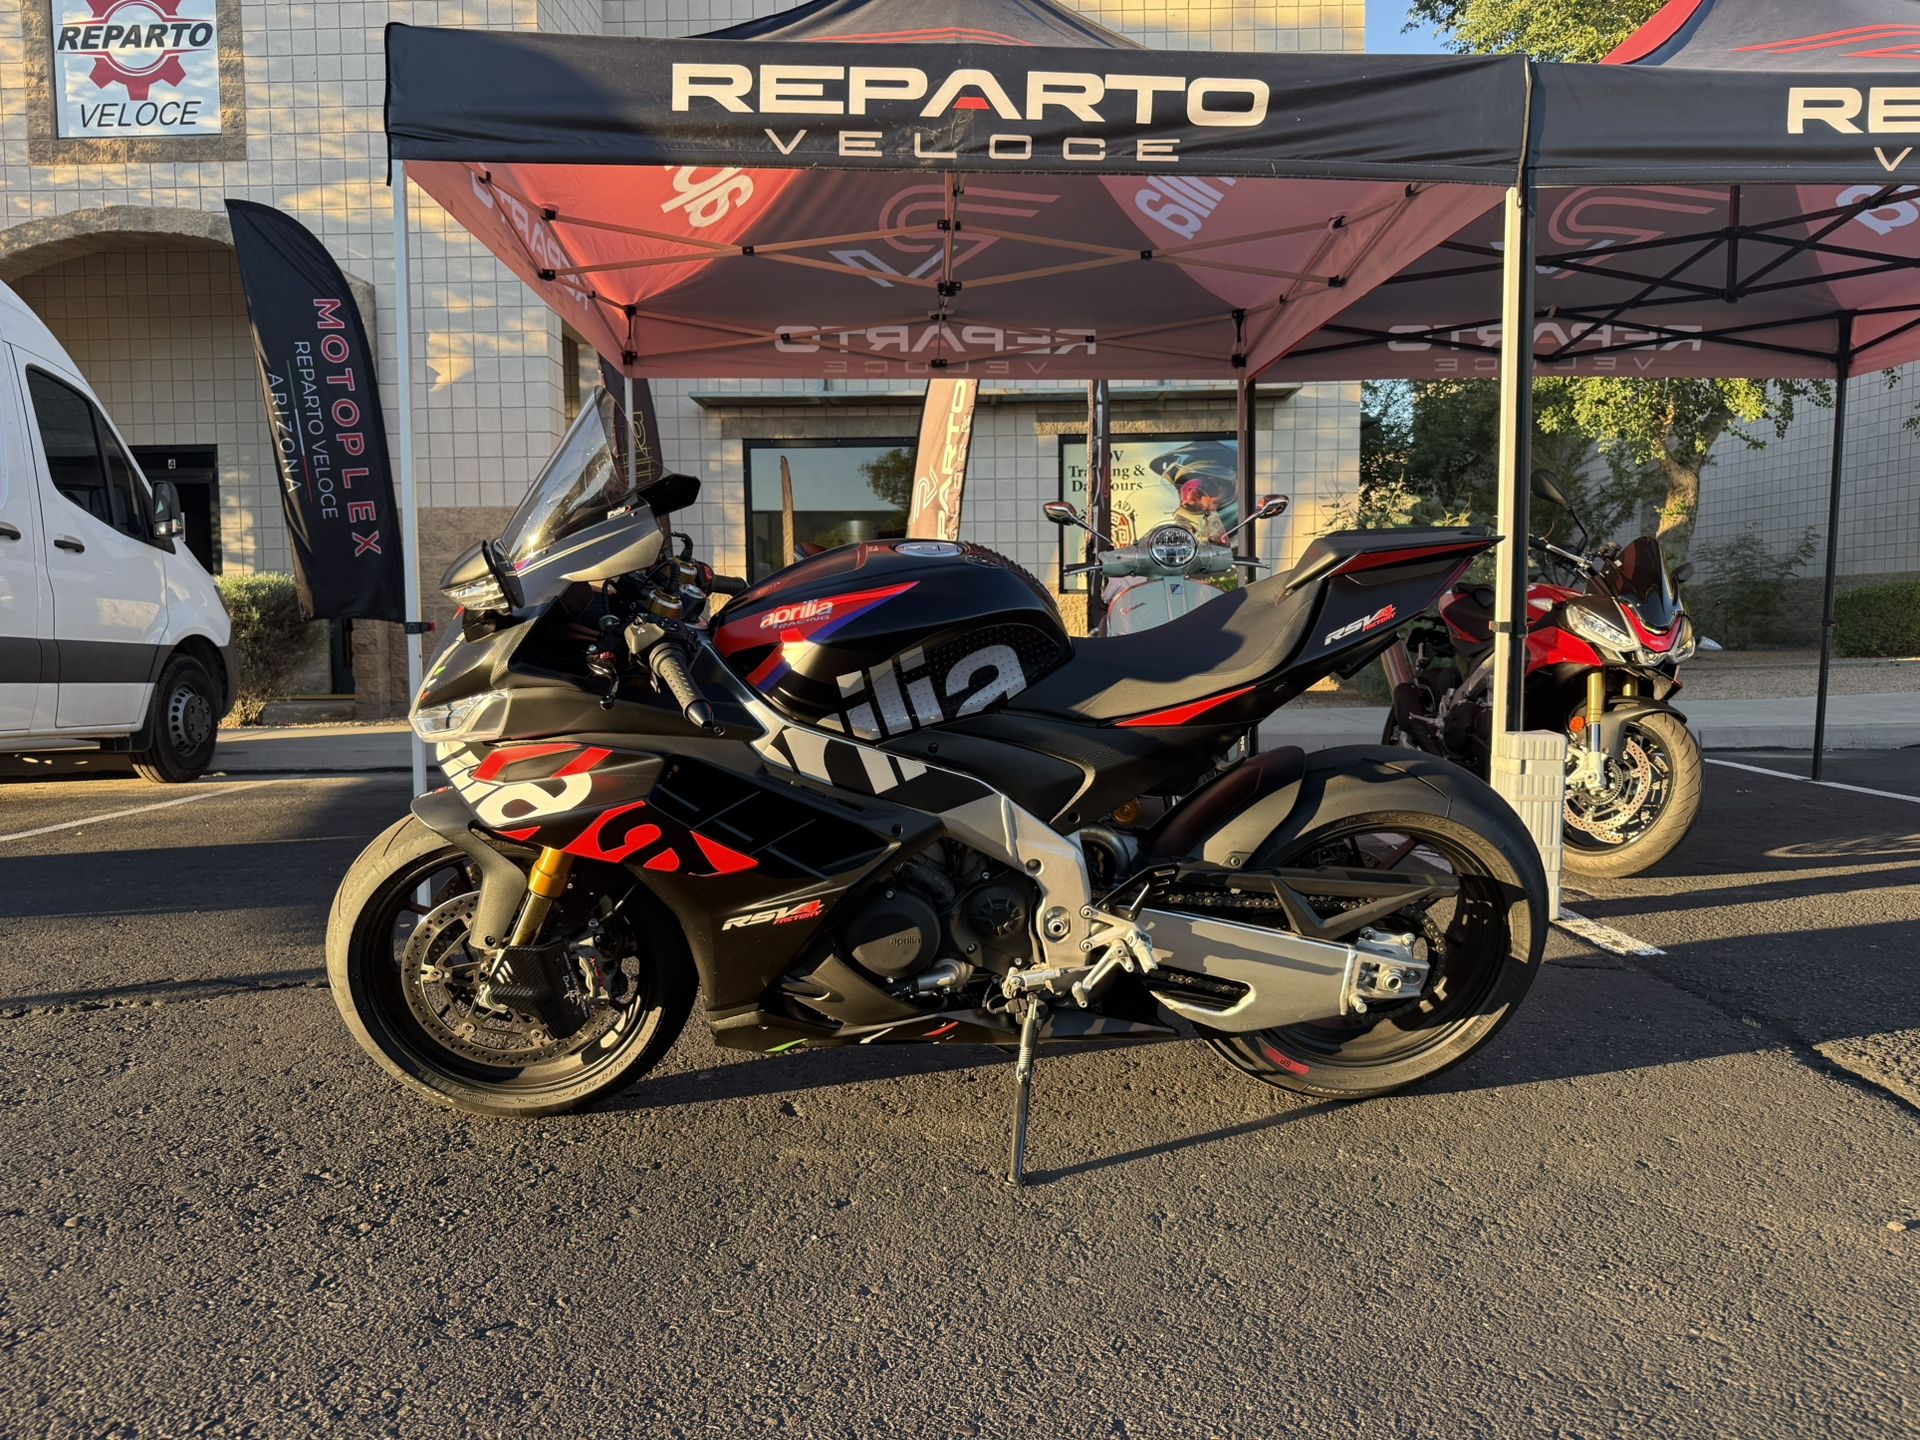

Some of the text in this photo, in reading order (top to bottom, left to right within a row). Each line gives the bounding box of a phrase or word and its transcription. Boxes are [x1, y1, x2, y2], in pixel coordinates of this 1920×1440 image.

[57, 22, 213, 51] REPARTO
[671, 62, 1271, 127] REPARTO
[80, 100, 202, 128] VELOCE
[764, 128, 1181, 162] VELOCE
[267, 372, 301, 493] ARIZONA
[294, 341, 338, 519] REPARTO VELOCE
[313, 298, 382, 557] MOTOPLEX
[1133, 464, 1145, 477] &
[760, 599, 833, 628] aprilia
[1324, 604, 1396, 646] RSV4
[721, 899, 825, 931] RSV4
